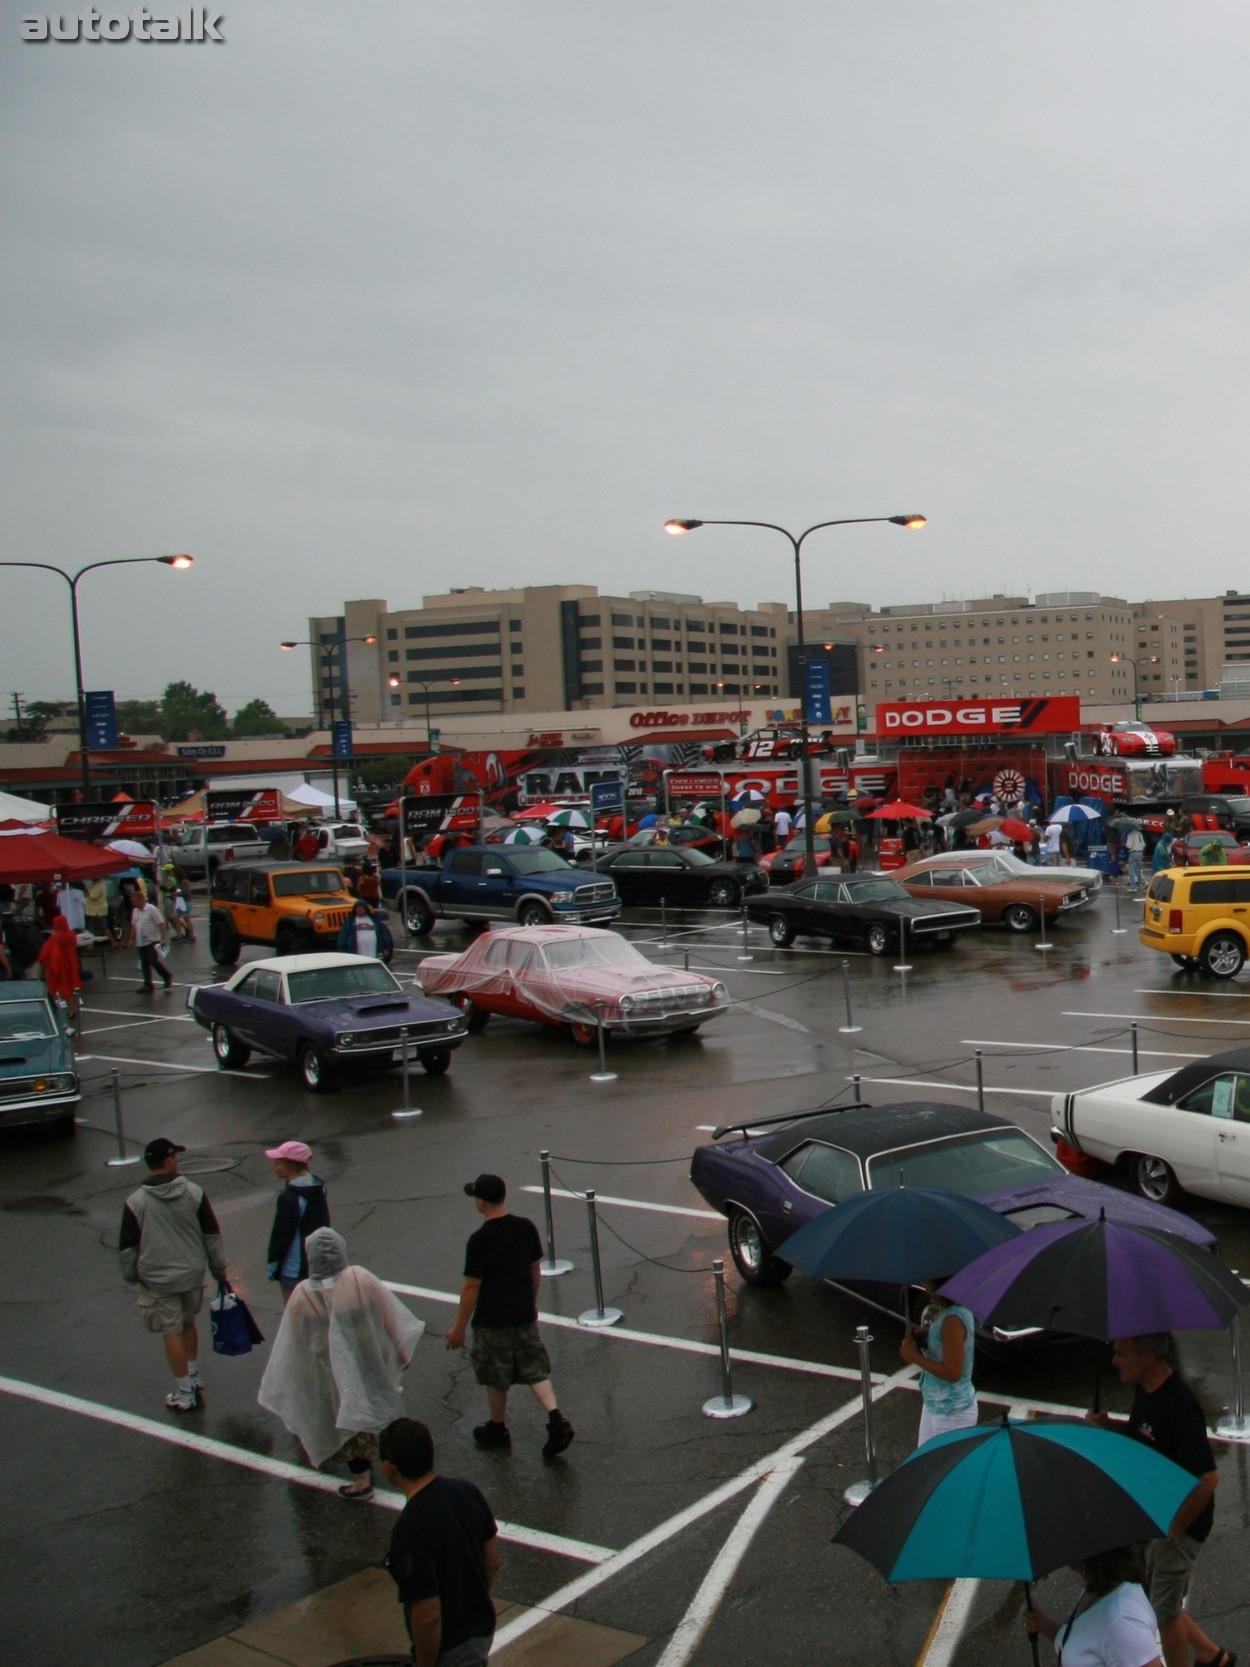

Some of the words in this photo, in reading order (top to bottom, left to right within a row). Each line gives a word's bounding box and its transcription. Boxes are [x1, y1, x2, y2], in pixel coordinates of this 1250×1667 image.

[630, 711, 689, 728] Office
[691, 710, 751, 724] DEPOT
[886, 706, 1021, 727] DODGE
[748, 740, 775, 757] 12
[526, 771, 620, 795] RAM
[1069, 772, 1123, 793] DODGE
[60, 813, 151, 825] CHARGER
[408, 809, 441, 819] RAM
[444, 806, 475, 817] 1500
